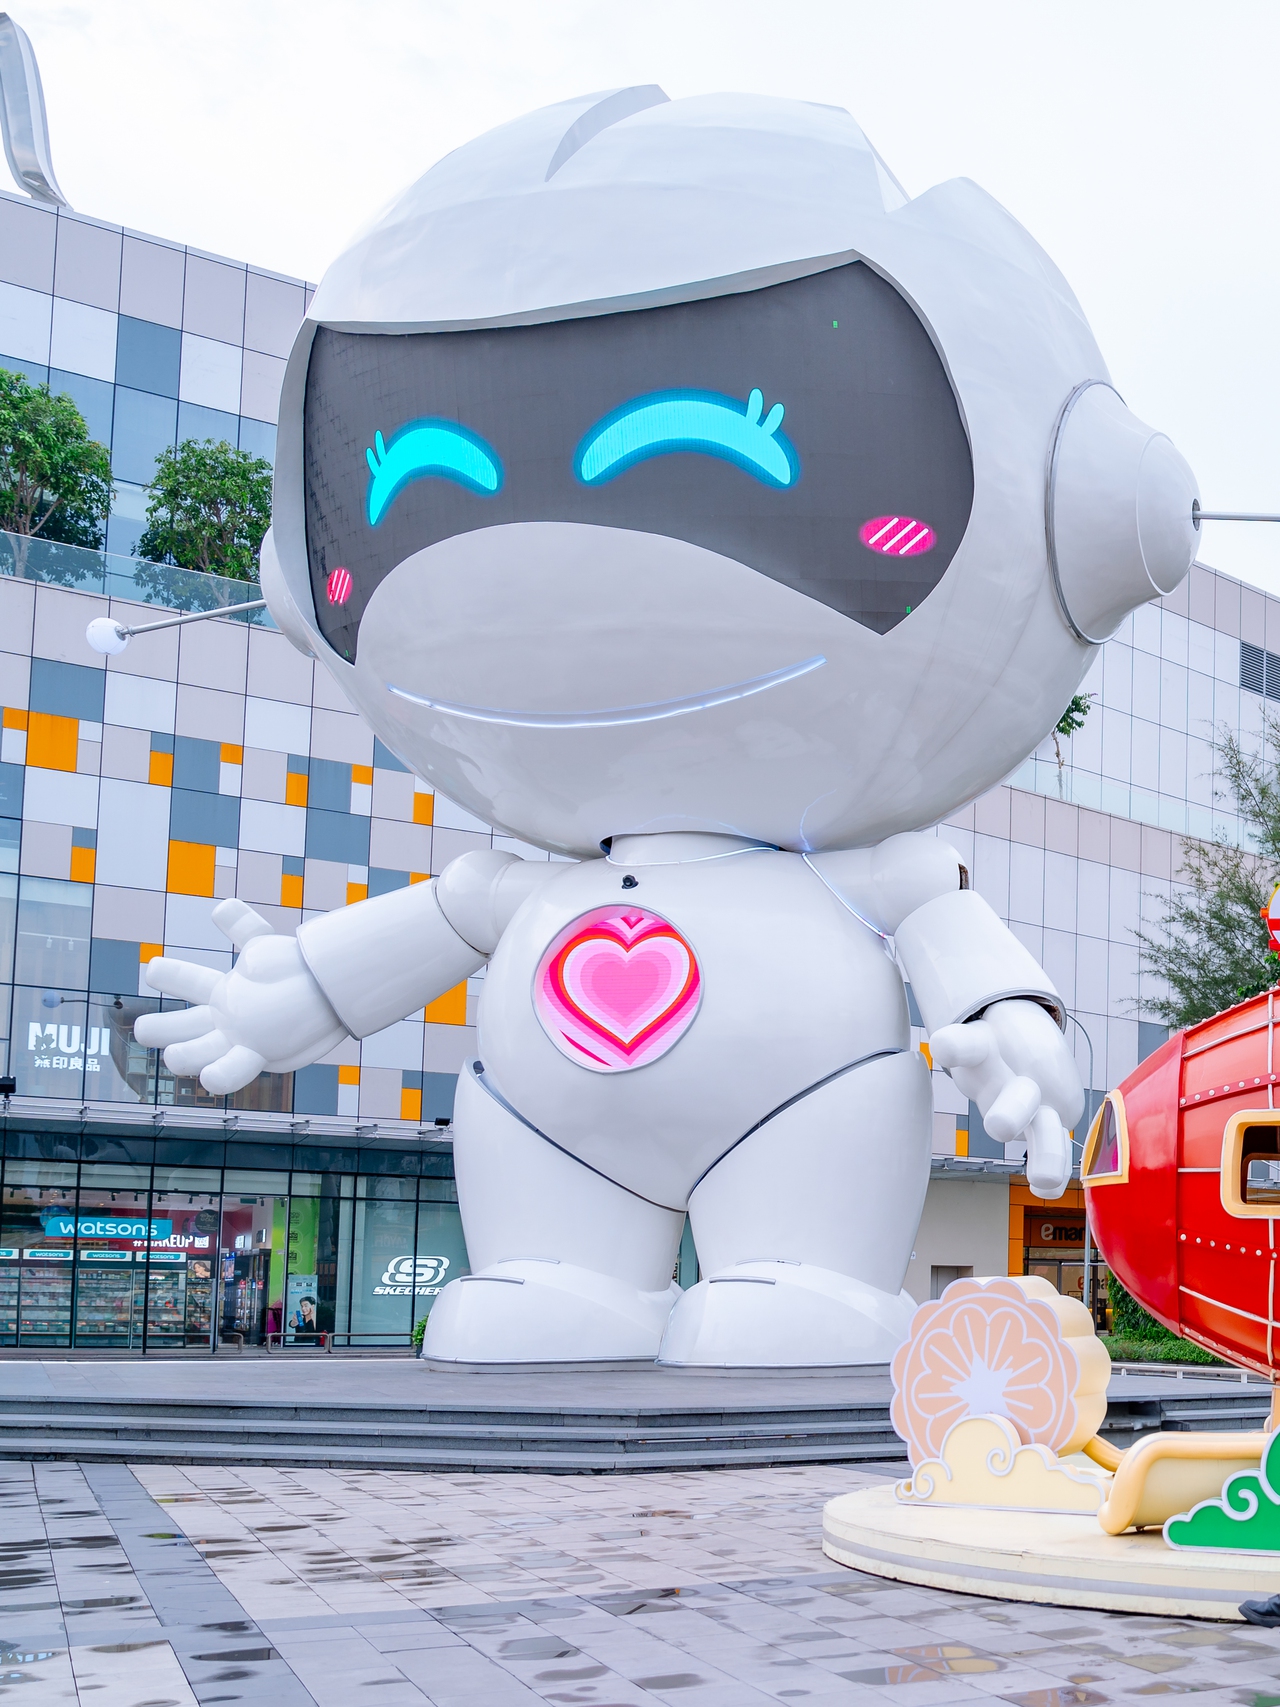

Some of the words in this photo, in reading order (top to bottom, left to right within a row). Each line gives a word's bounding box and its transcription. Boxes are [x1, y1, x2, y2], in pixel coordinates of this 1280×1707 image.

[28, 1022, 110, 1056] MUJI
[34, 1055, 100, 1072] 無印良品
[60, 1222, 158, 1236] watsons
[1040, 1223, 1085, 1241] emar
[373, 1286, 444, 1295] SKECHER
